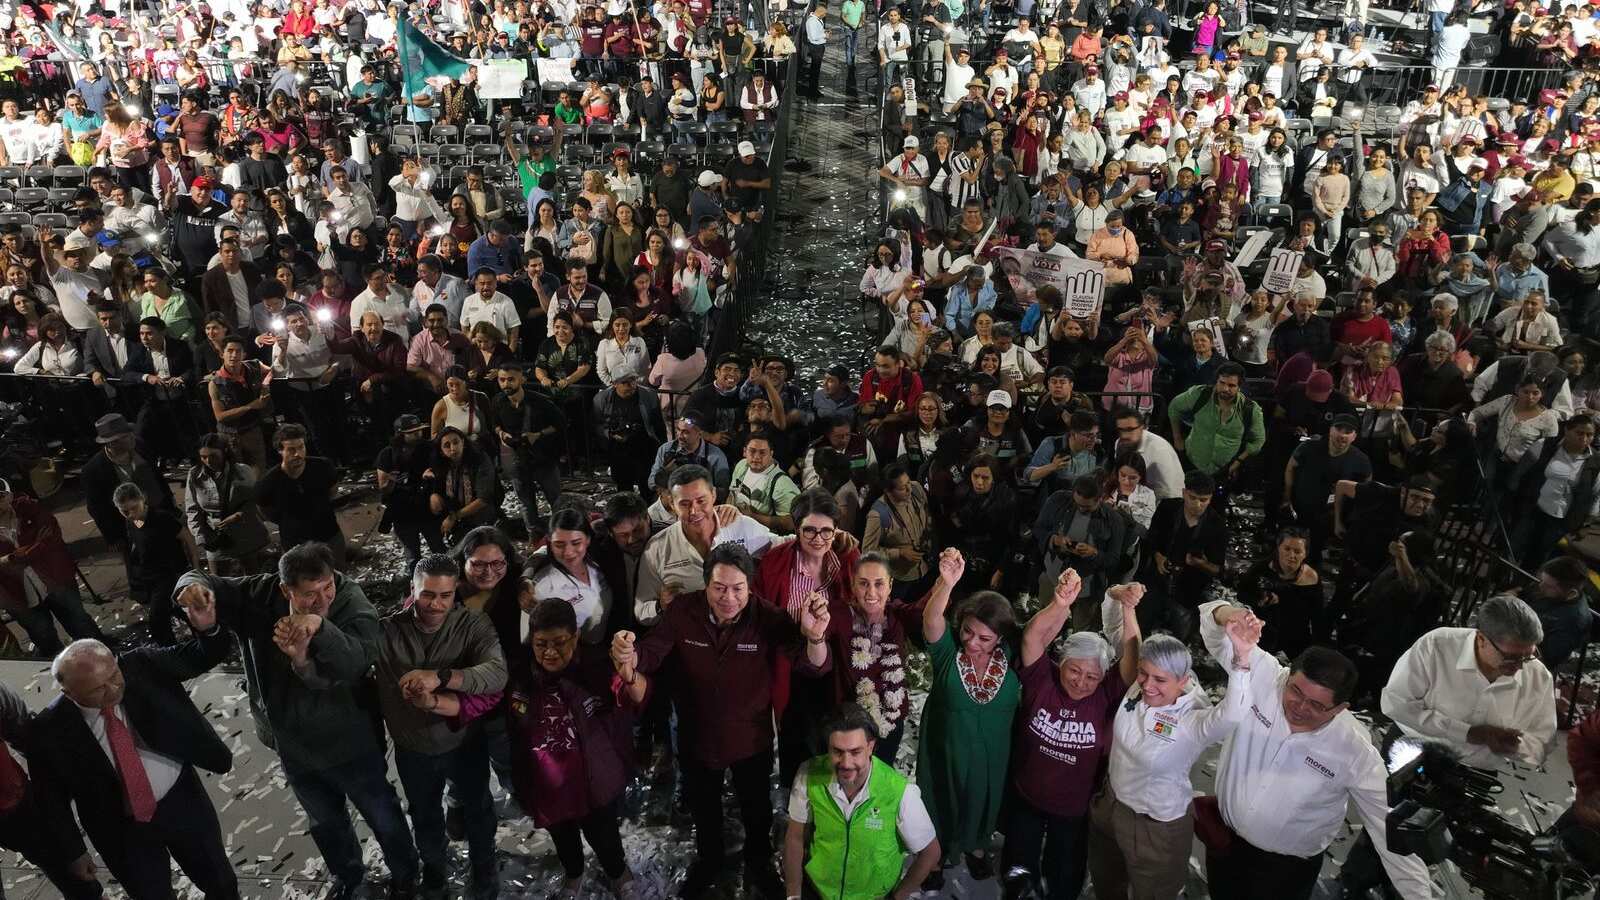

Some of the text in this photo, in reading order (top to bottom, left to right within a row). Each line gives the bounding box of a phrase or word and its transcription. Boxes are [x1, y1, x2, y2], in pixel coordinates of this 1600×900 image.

[1033, 260, 1061, 271] VOTA
[1037, 708, 1096, 735] CLAUDIA
[1154, 711, 1178, 725] morena
[1032, 716, 1096, 744] SHEINBAUM
[1040, 734, 1081, 750] PRESIDENTA
[1039, 745, 1077, 763] morena
[1305, 756, 1336, 778] morena
